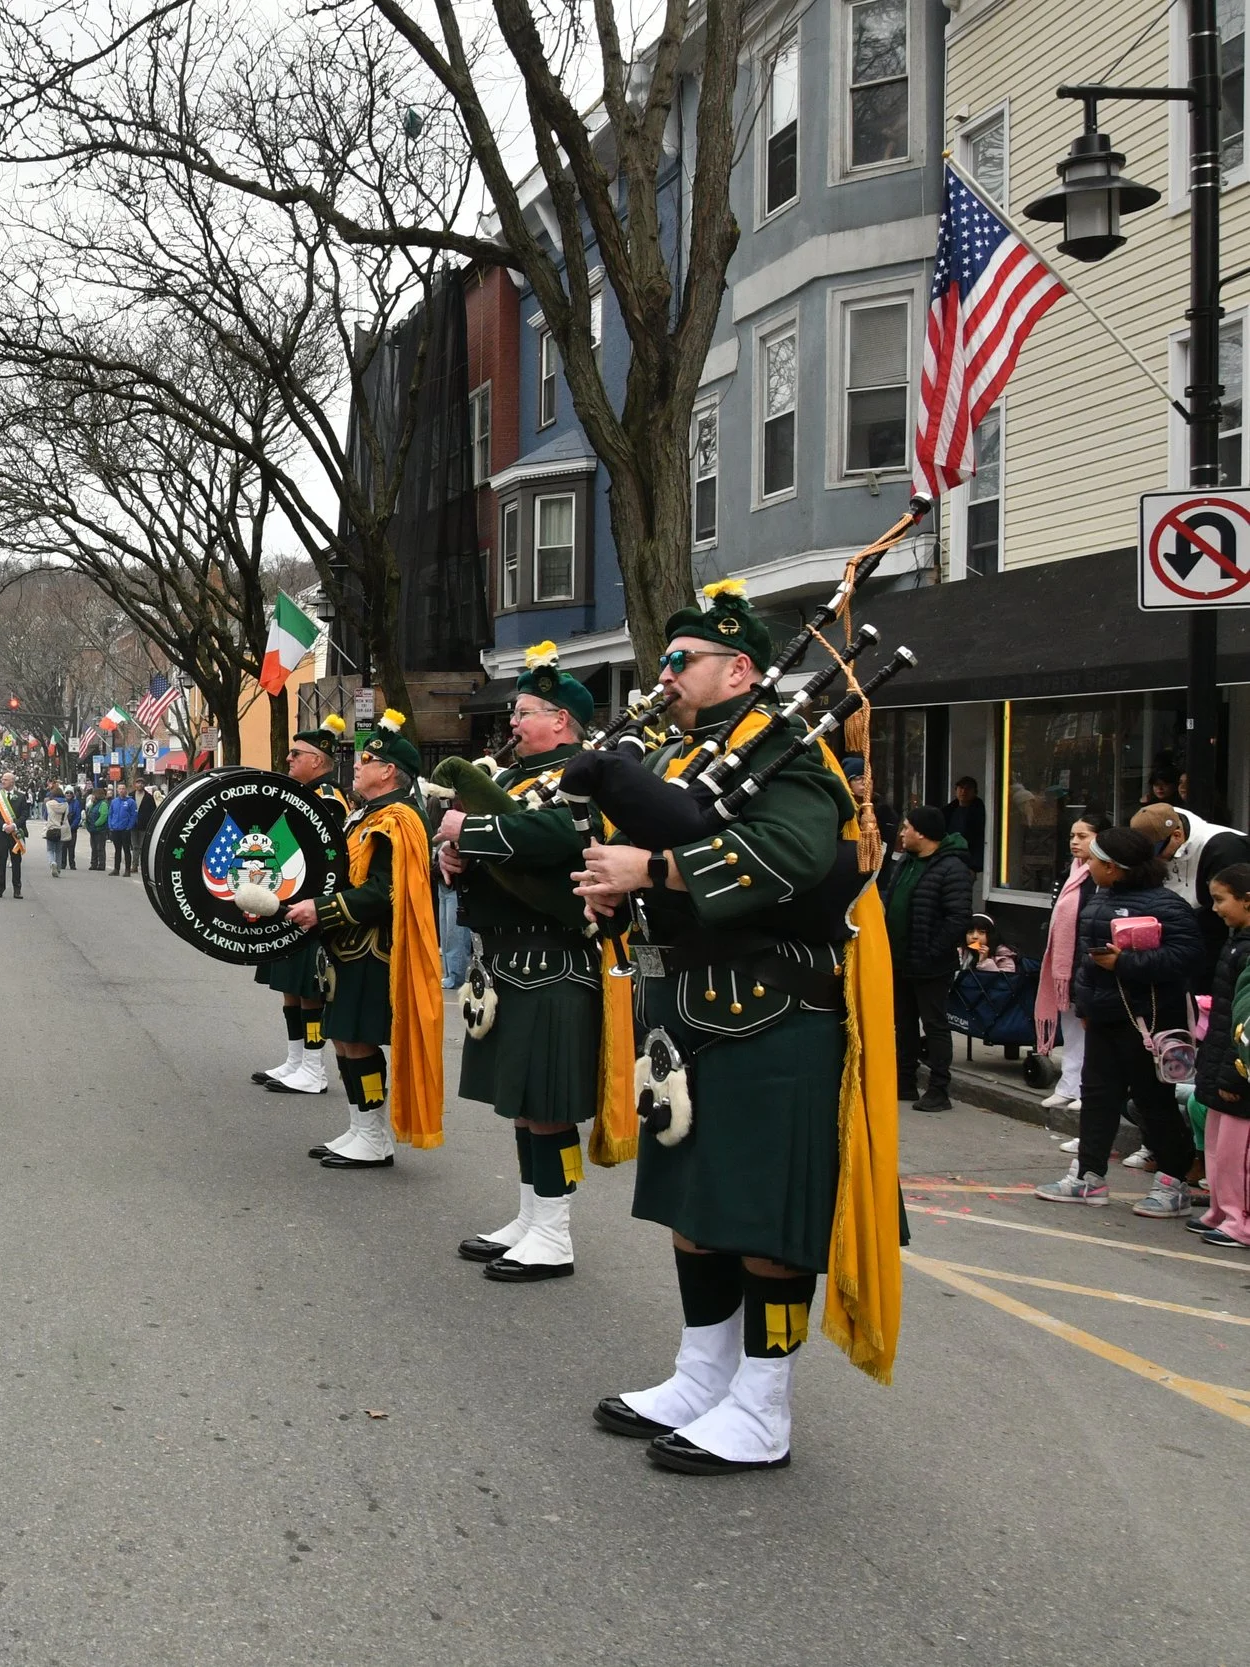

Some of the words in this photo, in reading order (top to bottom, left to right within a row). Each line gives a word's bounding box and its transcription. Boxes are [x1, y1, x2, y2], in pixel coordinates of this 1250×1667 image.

[1085, 669, 1131, 687] SHOP
[179, 796, 218, 844] ANCIENT
[220, 785, 258, 801] ORDER
[262, 785, 279, 797] OF
[280, 792, 331, 844] HIBERNIANS
[171, 870, 195, 921] EDWARD
[194, 919, 204, 933] V.
[202, 928, 245, 952] LARKIN
[323, 872, 336, 896] AND
[212, 917, 262, 935] ROCKLAND
[264, 926, 280, 934] CO.
